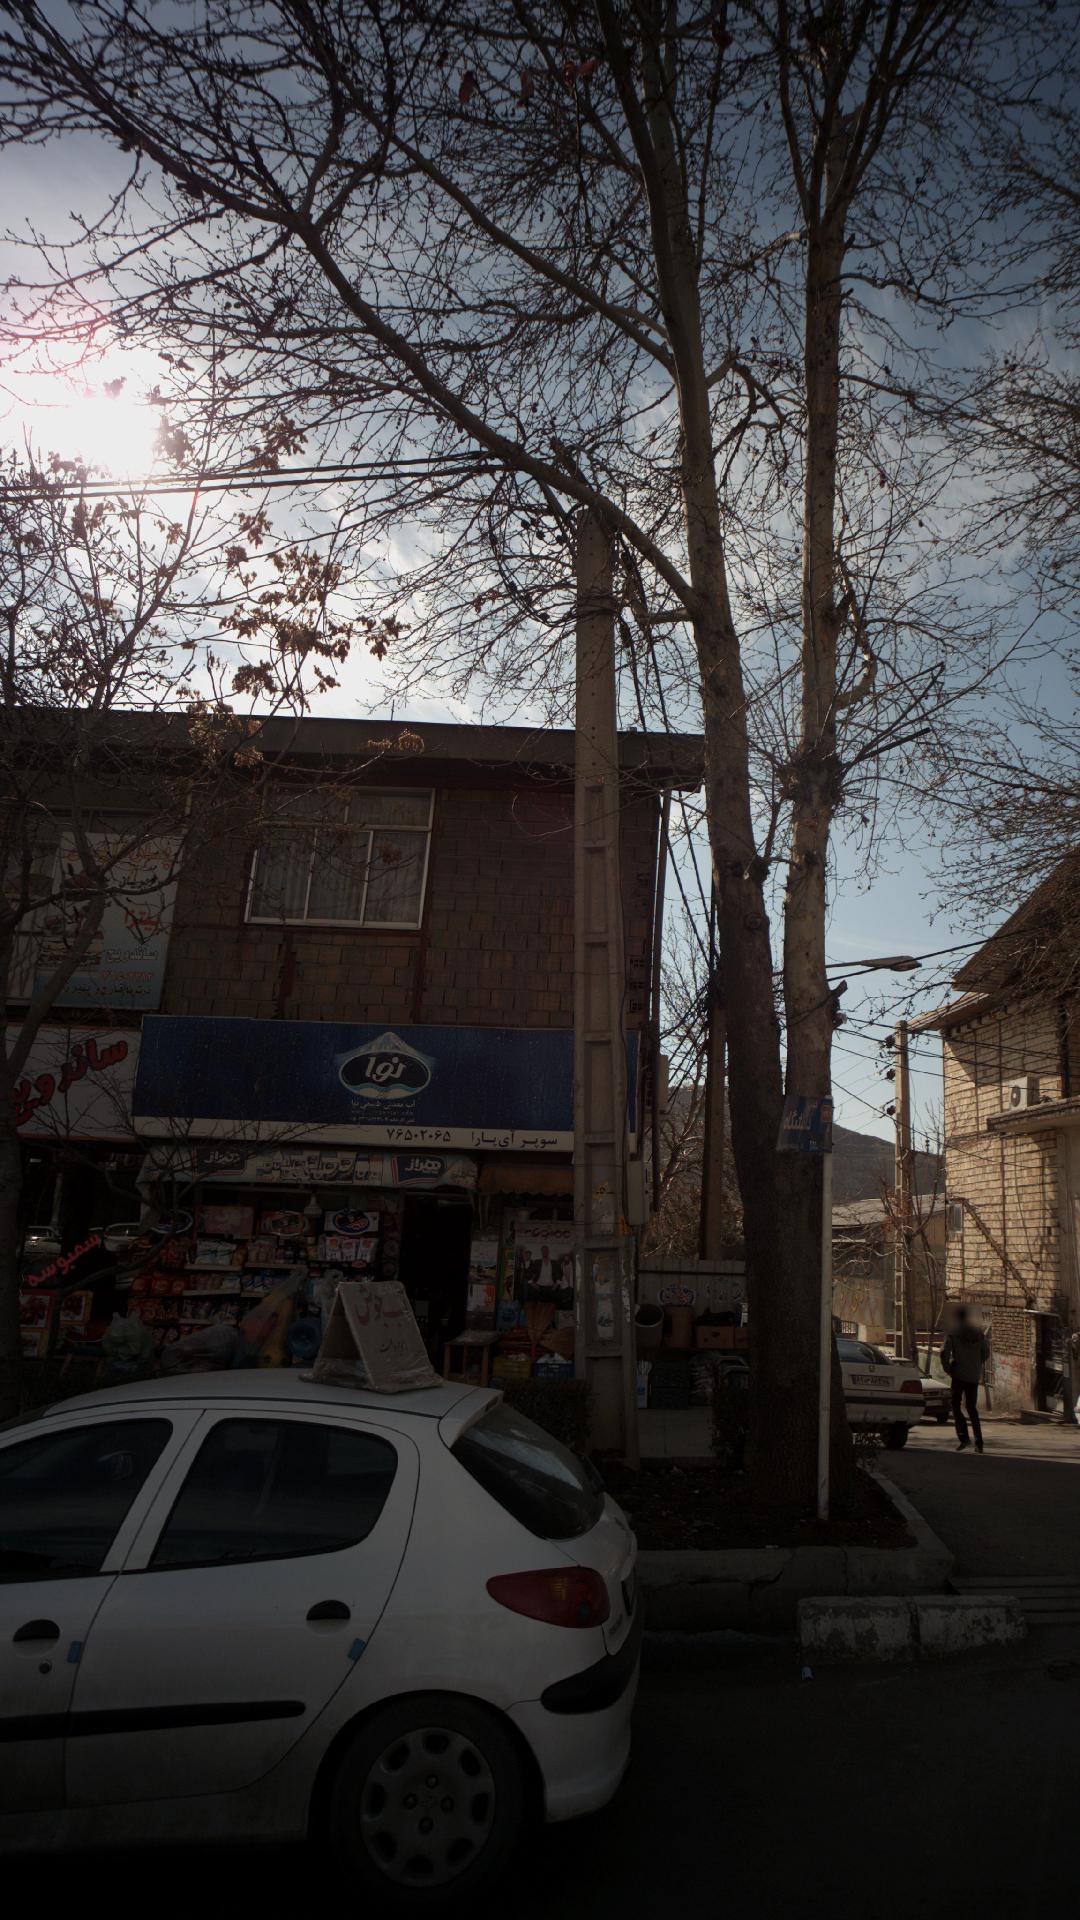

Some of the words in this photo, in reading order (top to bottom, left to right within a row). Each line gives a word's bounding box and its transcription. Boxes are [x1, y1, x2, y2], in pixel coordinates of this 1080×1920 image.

[365, 1056, 407, 1082] نوا
[386, 1127, 451, 1142] ۷۶۵۰۲۰۶۵
[521, 1136, 558, 1149] سوپر
[27, 1234, 102, 1287] سمبوسه
